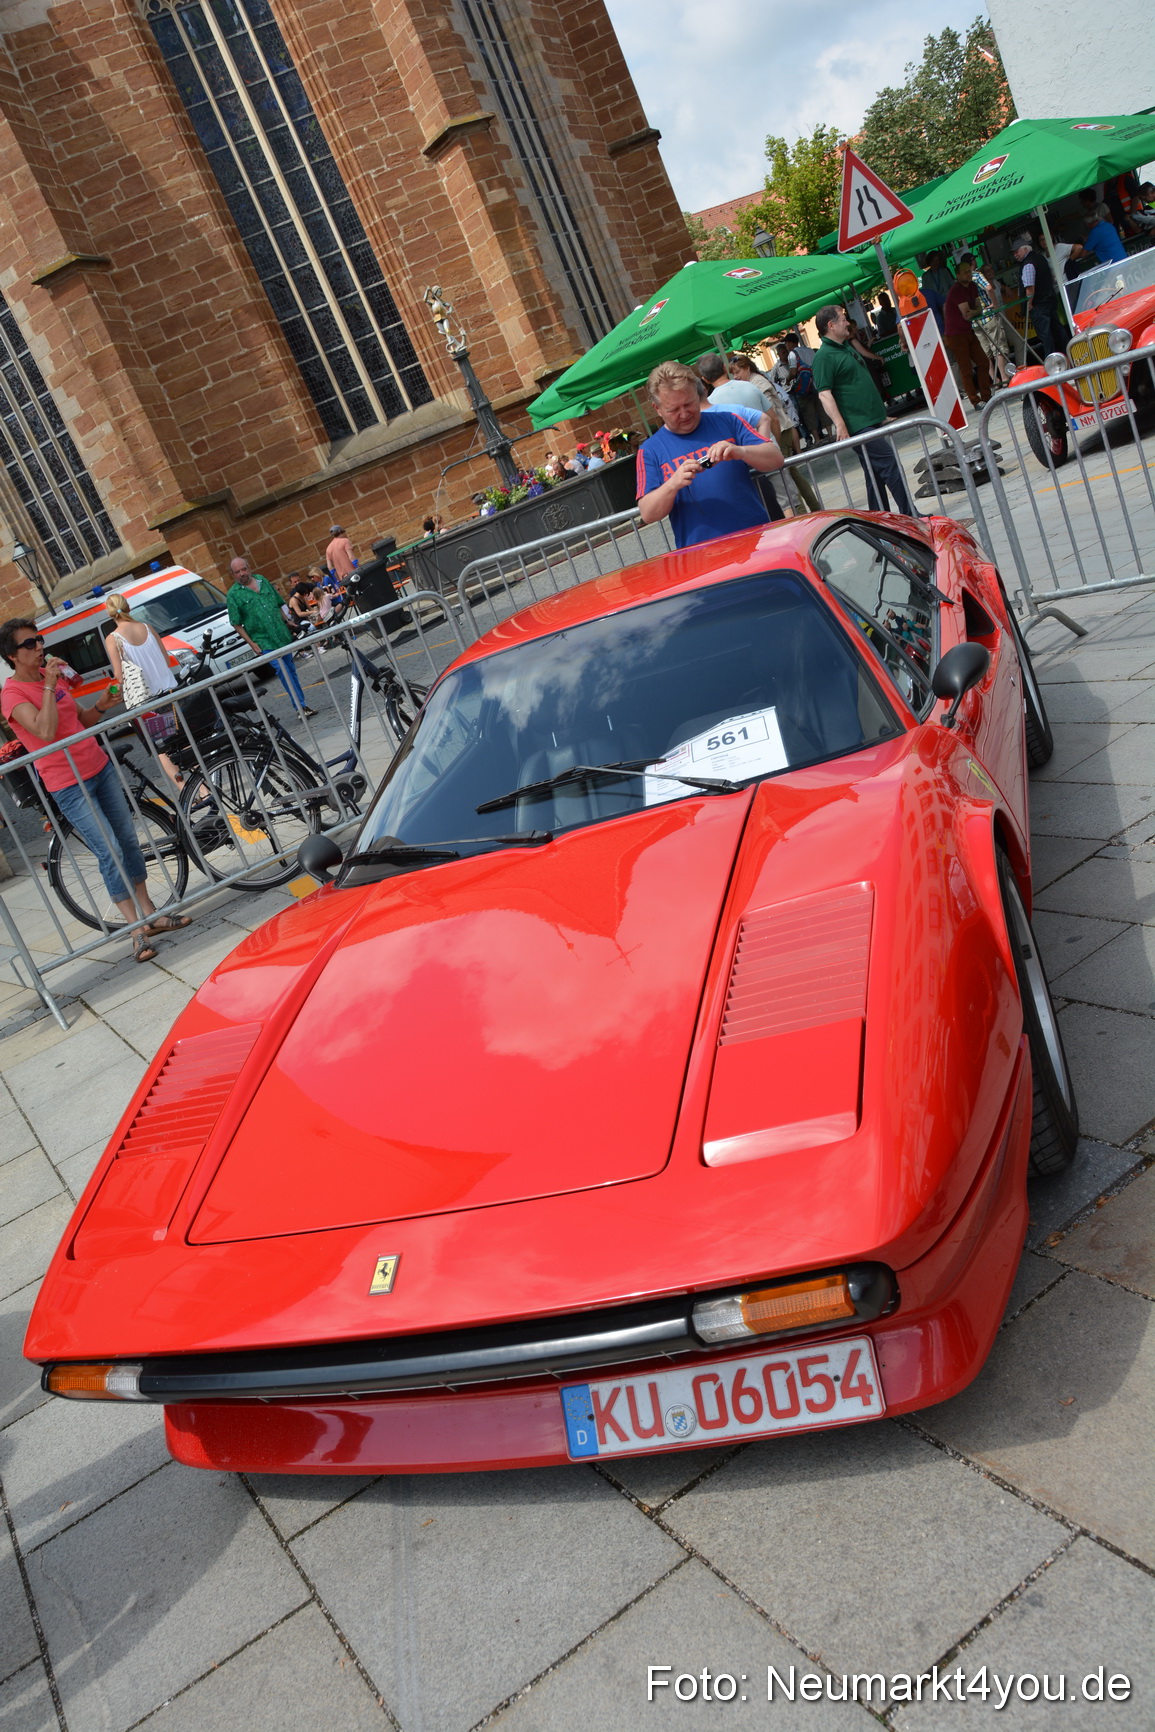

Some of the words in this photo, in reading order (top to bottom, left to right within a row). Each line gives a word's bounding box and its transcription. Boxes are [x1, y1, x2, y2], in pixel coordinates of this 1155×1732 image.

[925, 175, 1026, 225] Lammsbräu
[945, 171, 1017, 207] Neumarkter
[735, 267, 818, 297] Lammsbräu
[1080, 415, 1096, 427] NM
[707, 727, 749, 751] 561
[591, 1382, 665, 1444] KU
[692, 1349, 875, 1430] 06054
[576, 1429, 588, 1446] D
